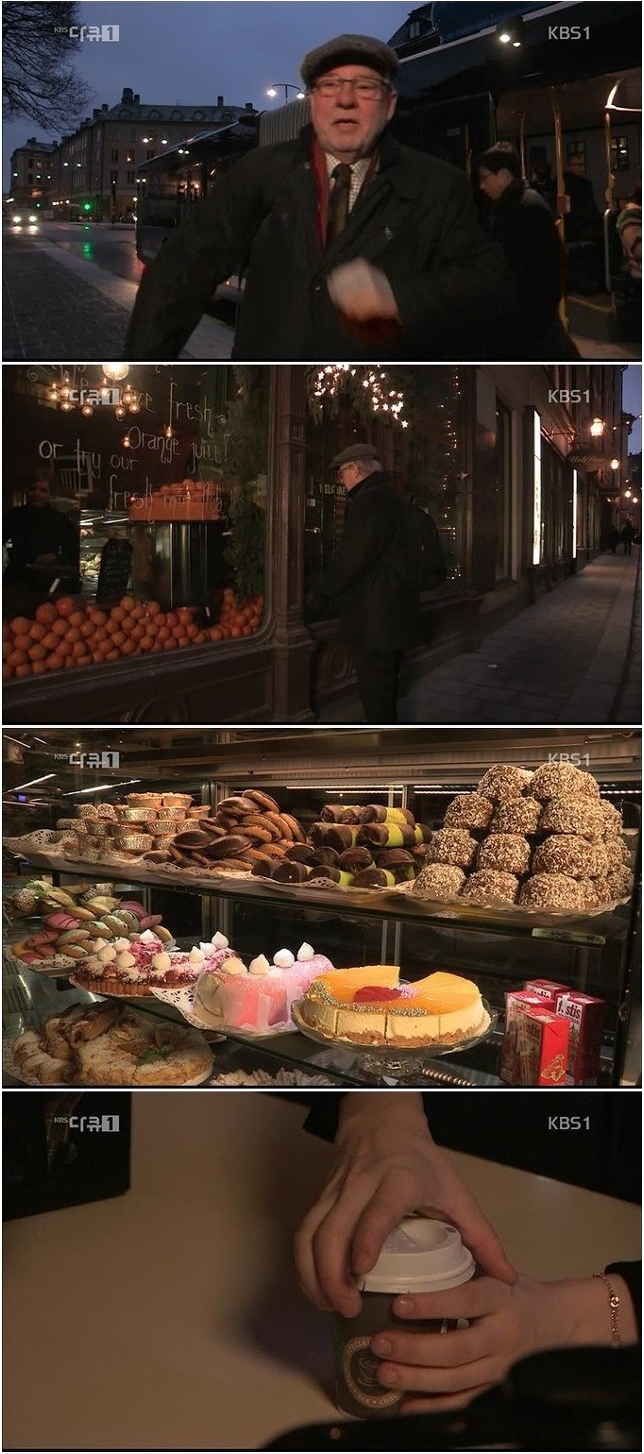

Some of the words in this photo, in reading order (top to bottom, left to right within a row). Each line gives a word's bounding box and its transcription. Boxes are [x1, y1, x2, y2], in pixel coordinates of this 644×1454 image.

[39, 440, 64, 458] or
[110, 455, 139, 470] our
[128, 426, 180, 464] Orange
